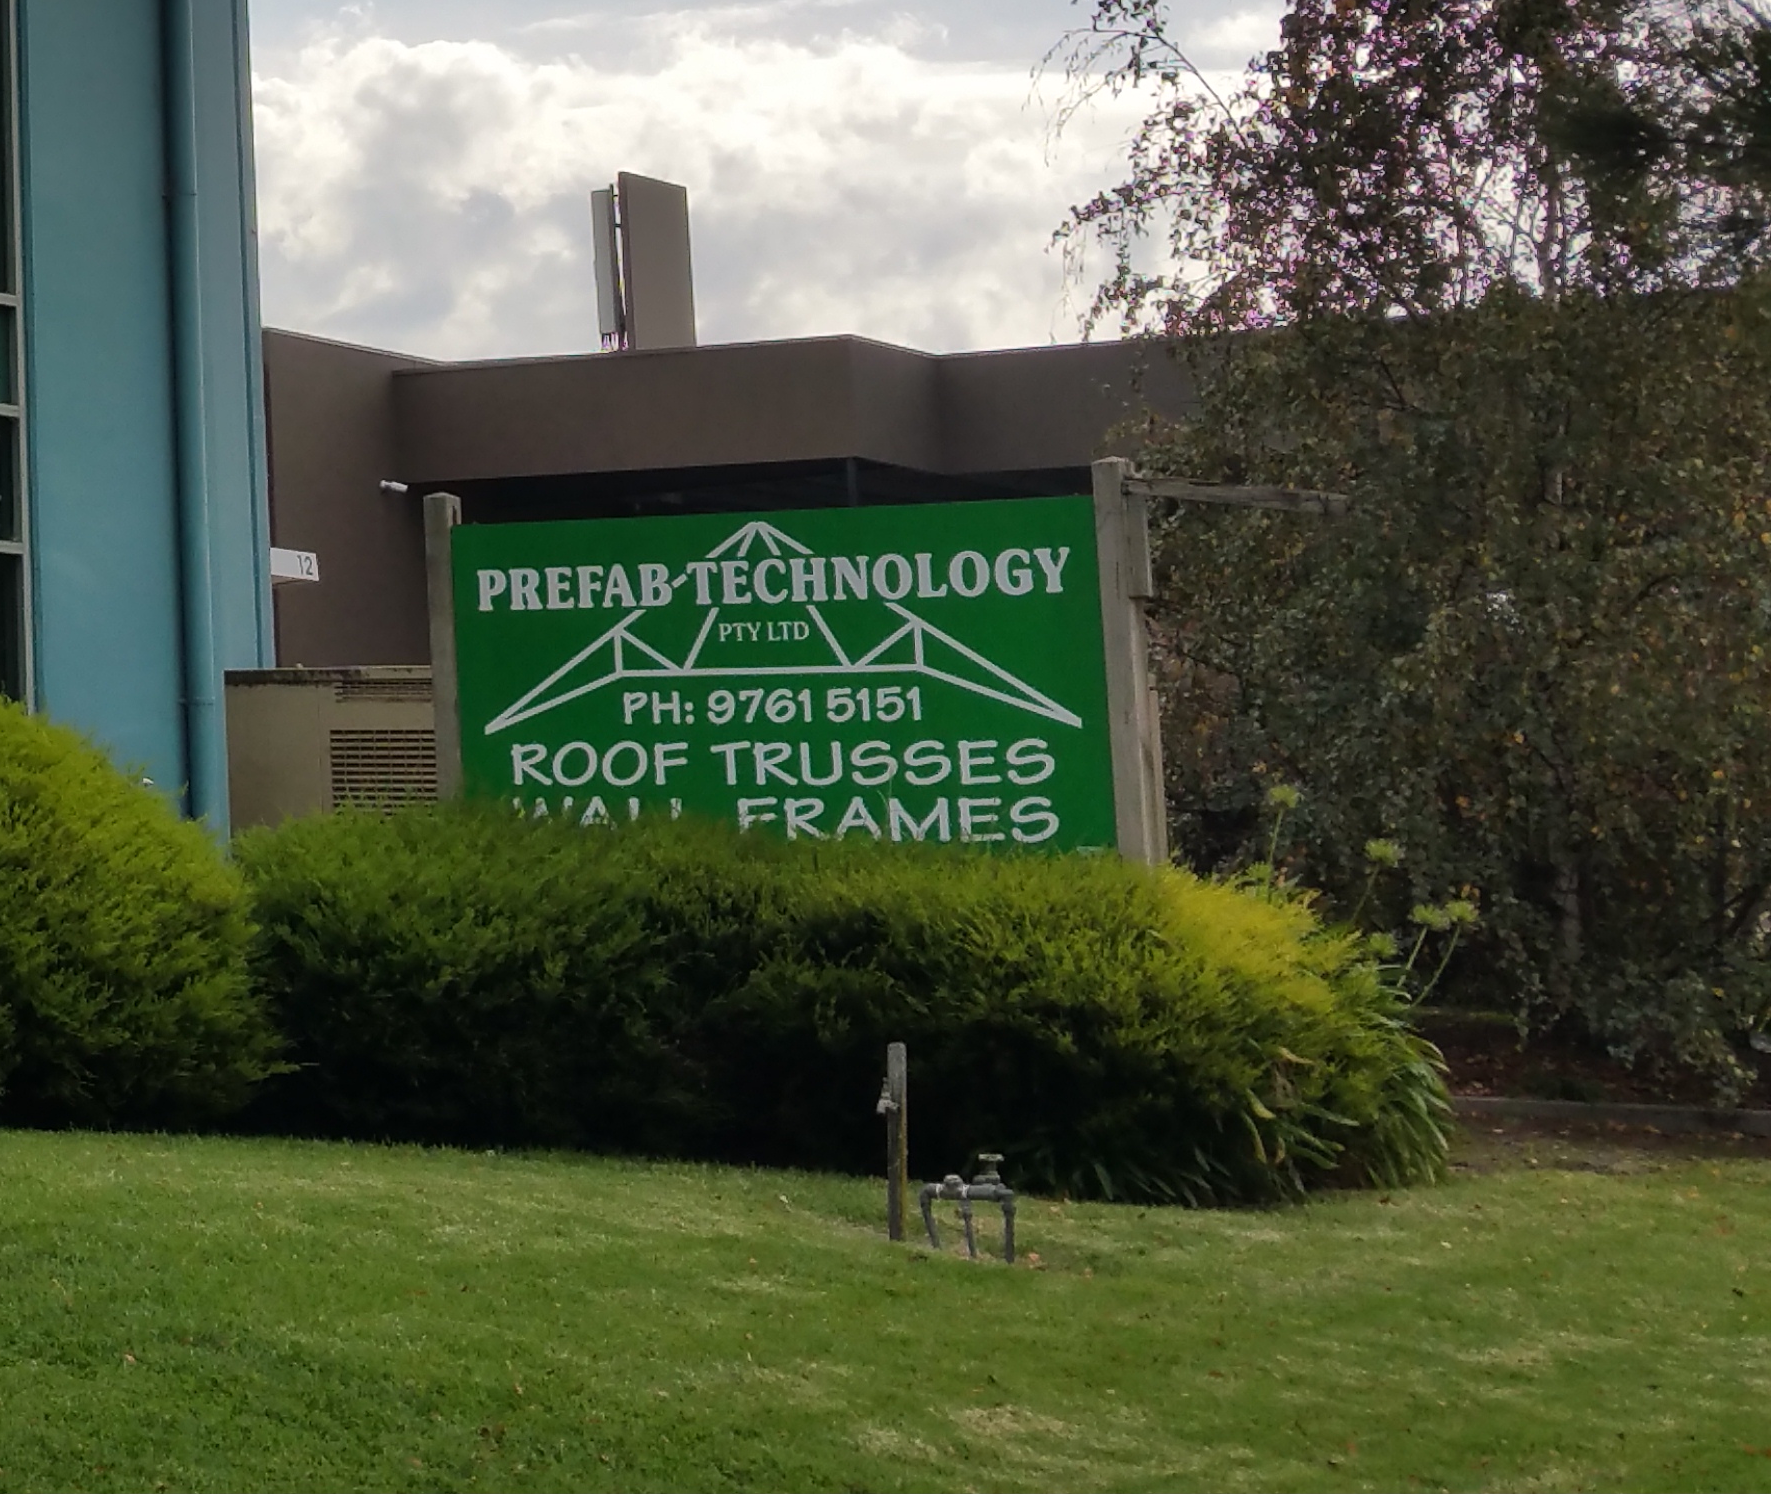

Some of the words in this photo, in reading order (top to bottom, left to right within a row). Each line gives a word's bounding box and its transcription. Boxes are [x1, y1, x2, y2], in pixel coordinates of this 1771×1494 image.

[296, 554, 314, 576] 12
[686, 546, 1070, 607] TECHNOLOGY
[718, 621, 761, 642] PTY
[767, 620, 810, 641] LTD
[623, 690, 695, 725] PH:
[707, 687, 812, 725] 9761
[826, 686, 922, 723] 5151
[511, 741, 689, 786] ROOF
[710, 738, 1056, 787] TRUSSES
[737, 796, 1060, 844] FRAMES
